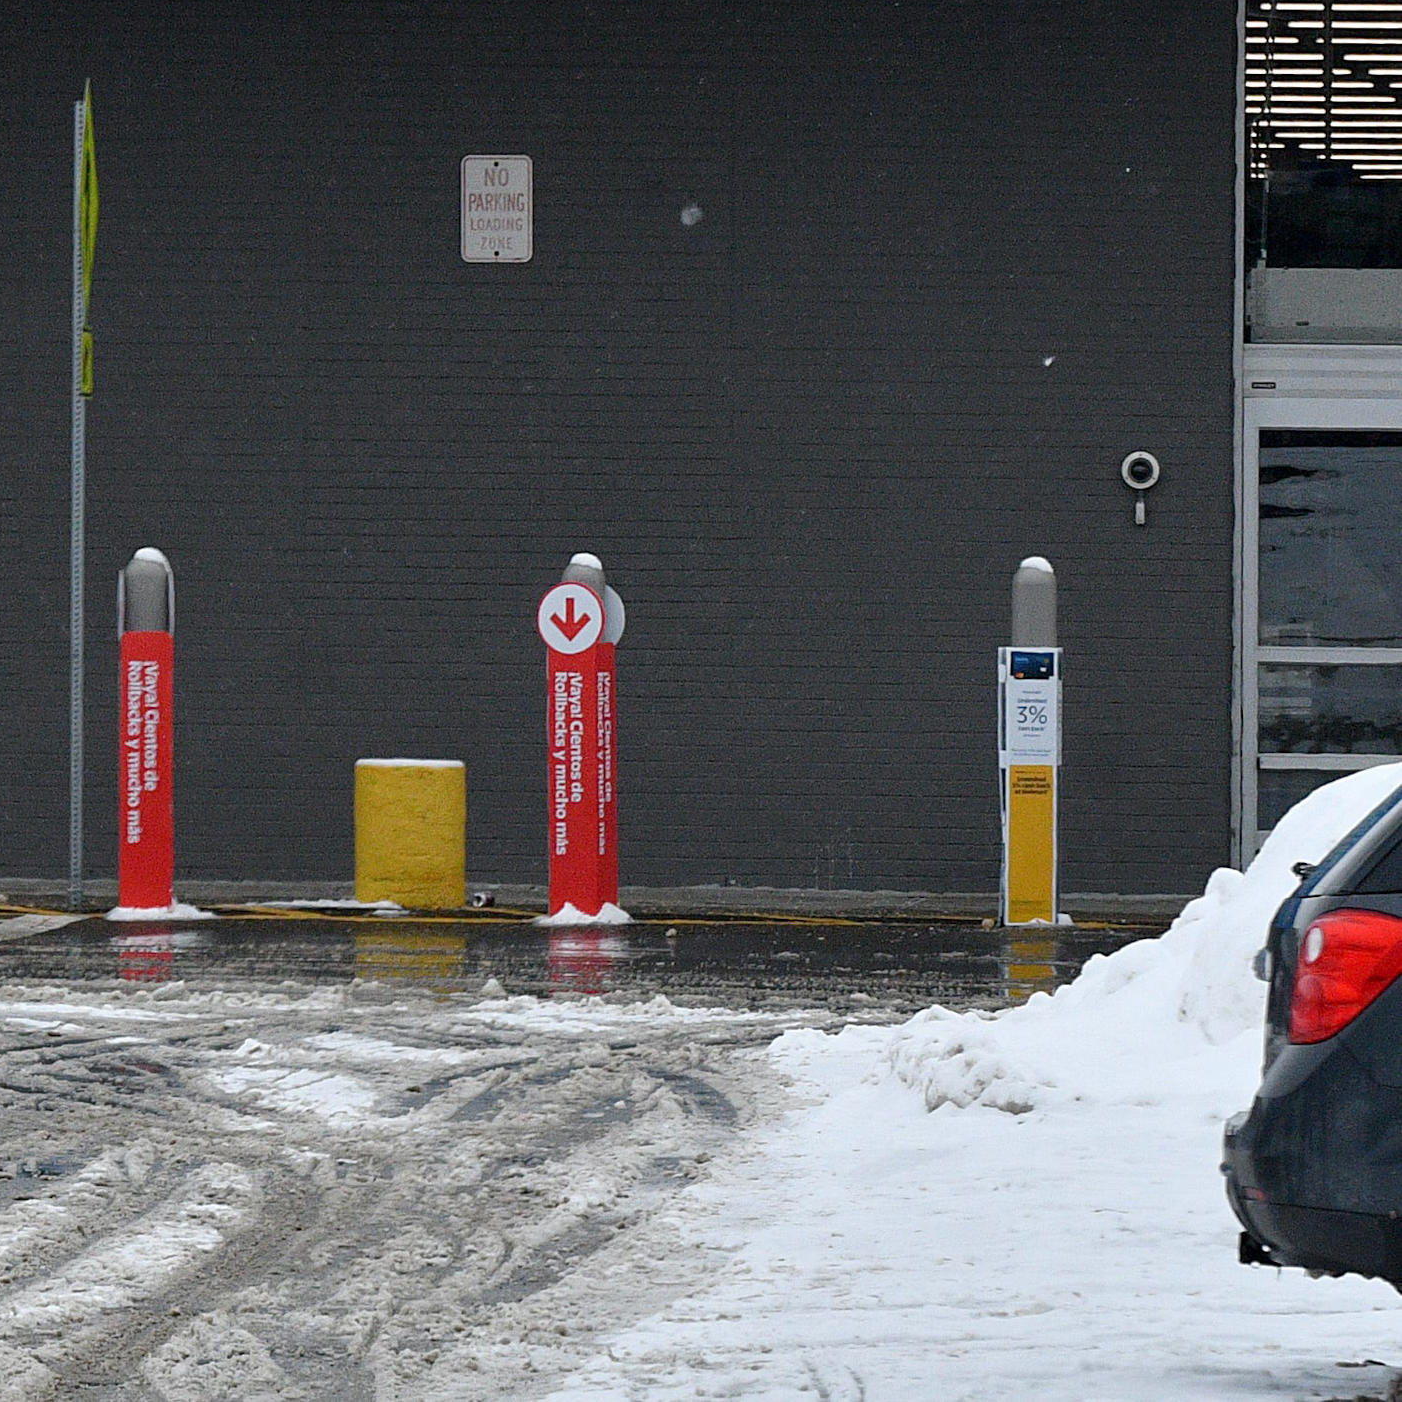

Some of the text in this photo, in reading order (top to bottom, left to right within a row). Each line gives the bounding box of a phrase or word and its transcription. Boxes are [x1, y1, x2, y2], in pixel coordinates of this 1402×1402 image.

[484, 168, 509, 187] NO
[468, 193, 525, 212] PARKING
[470, 218, 523, 231] LOADING
[480, 237, 513, 250] ZONE
[555, 671, 568, 747] Rollbacks
[1016, 705, 1048, 724] 3%
[552, 750, 566, 761] y
[555, 764, 569, 819] mucho
